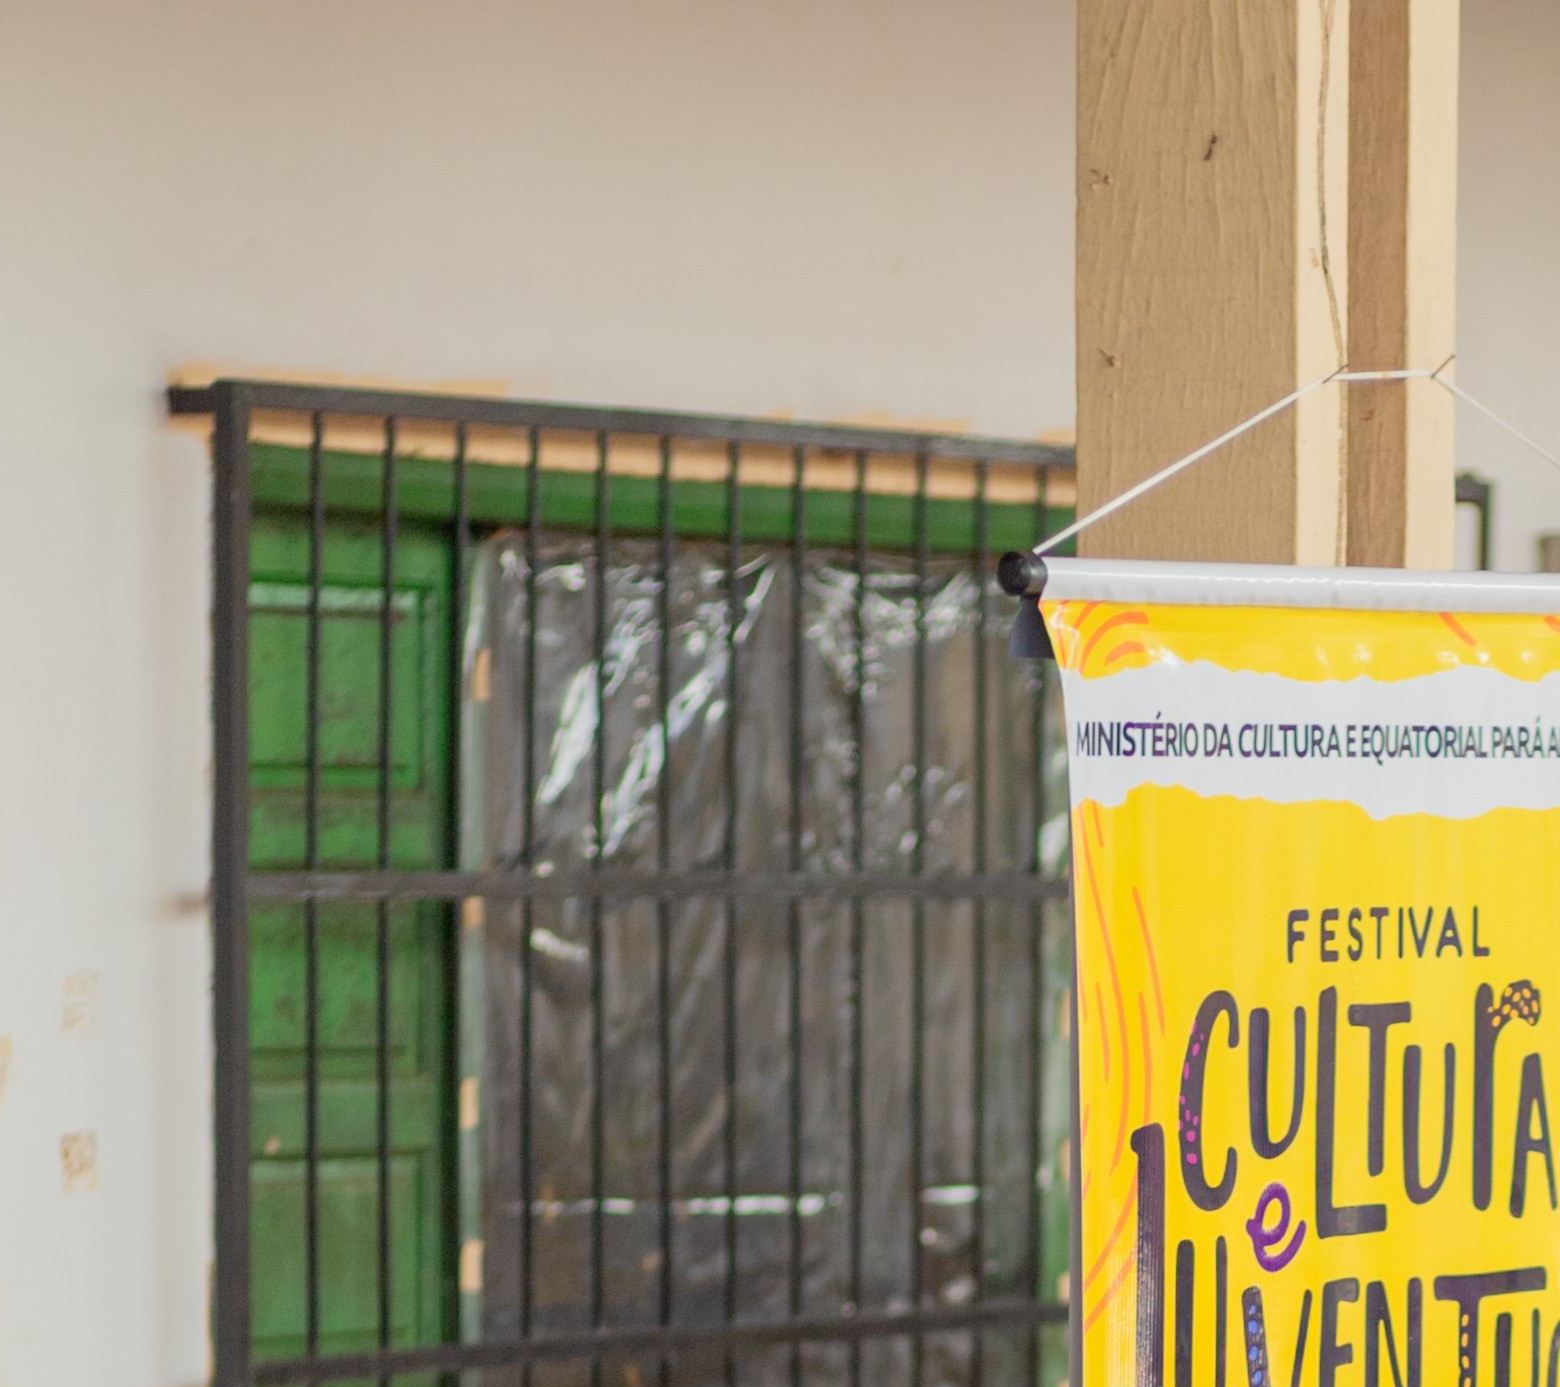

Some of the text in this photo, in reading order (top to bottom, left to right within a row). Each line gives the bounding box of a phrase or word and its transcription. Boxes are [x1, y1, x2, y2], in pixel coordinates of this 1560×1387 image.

[1076, 711, 1198, 757] MINISTÉRIO
[1204, 724, 1233, 757] DA
[1238, 724, 1340, 757] CULTURA
[1346, 725, 1357, 757] E
[1361, 725, 1487, 765] EQUATORIAL
[1492, 715, 1543, 758] PARÁ
[1287, 905, 1490, 962] FESTIVAL
[1246, 1183, 1306, 1273] e
